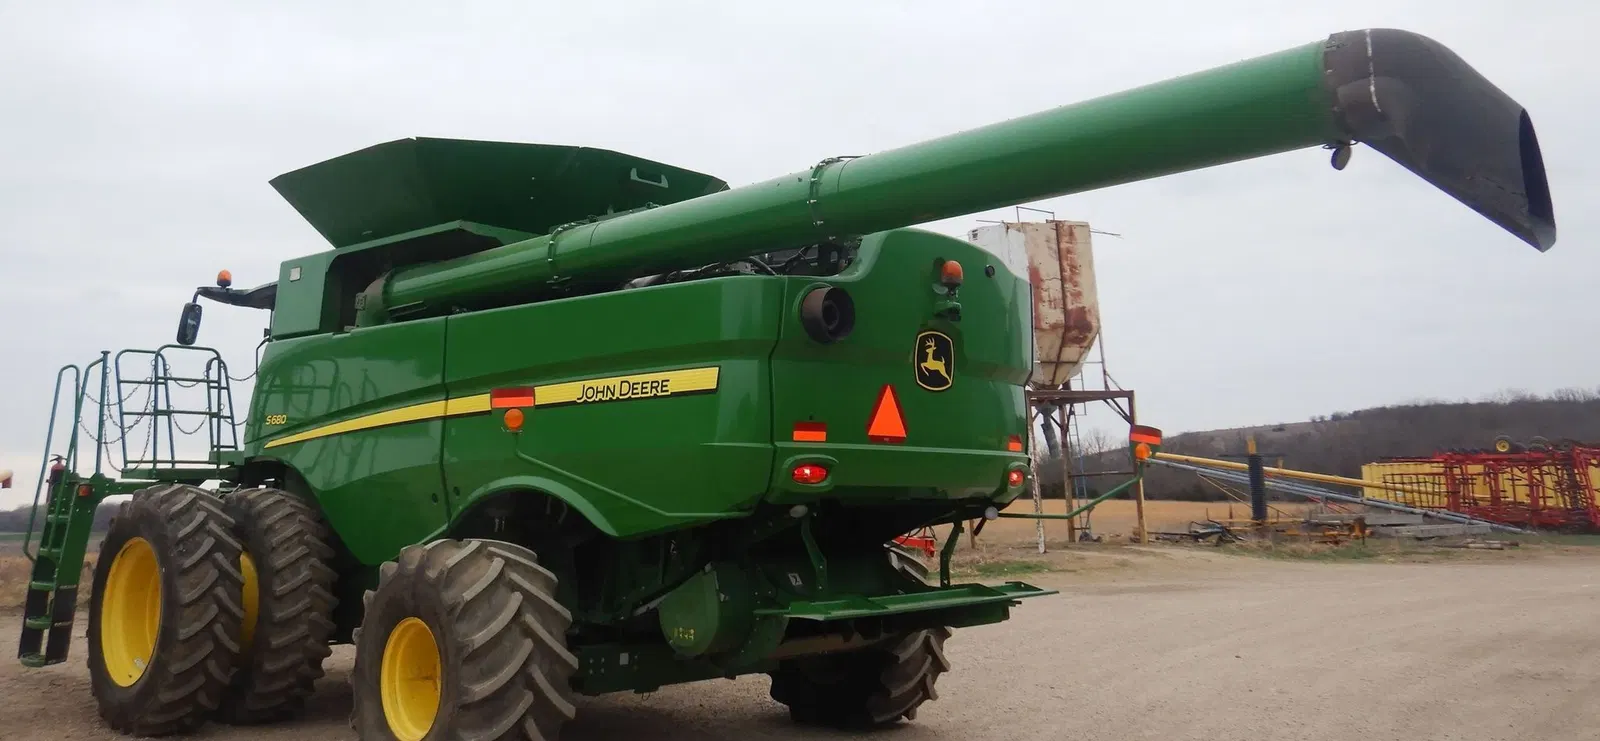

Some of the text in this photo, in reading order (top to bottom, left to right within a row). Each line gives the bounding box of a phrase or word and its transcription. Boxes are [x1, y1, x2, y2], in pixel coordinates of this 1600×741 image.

[576, 379, 670, 401] JOHN DEERE
[265, 414, 287, 425] S680
